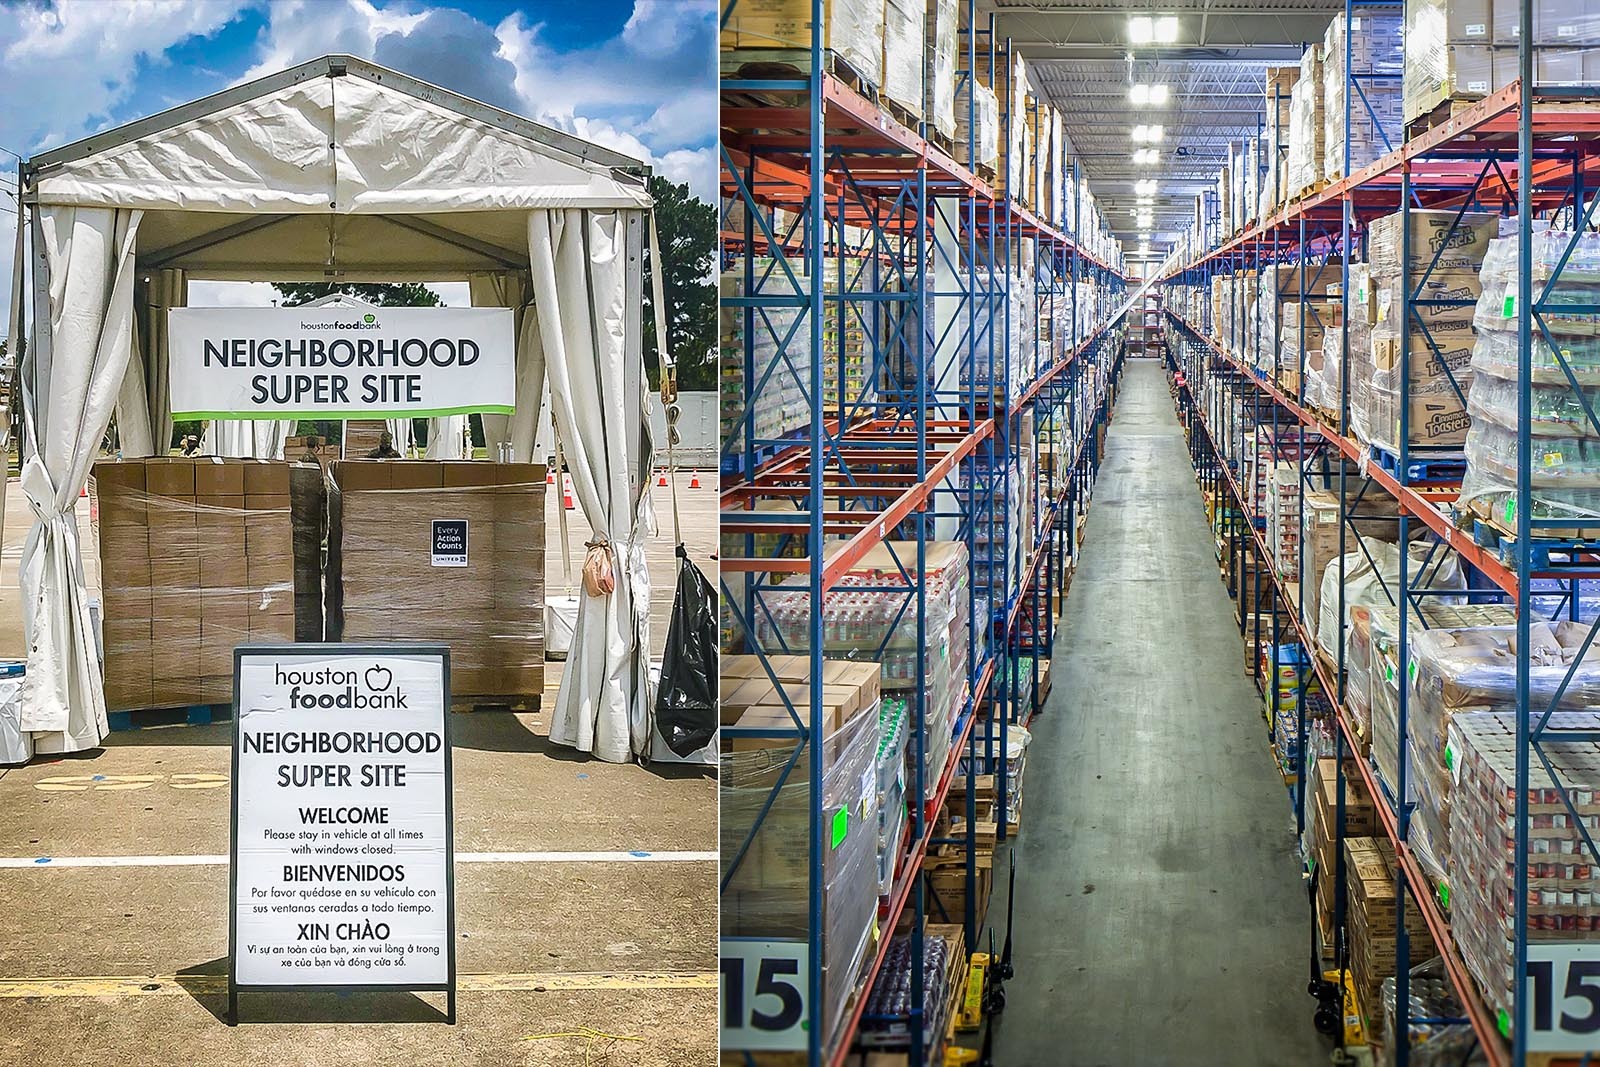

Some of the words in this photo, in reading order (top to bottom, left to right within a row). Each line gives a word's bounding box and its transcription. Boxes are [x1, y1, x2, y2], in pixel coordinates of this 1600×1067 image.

[301, 320, 381, 330] houstonfoodbank
[203, 338, 480, 368] NEIGHBORHOOD
[250, 374, 350, 405] SUPER
[360, 374, 422, 404] SITE
[1427, 417, 1471, 437] Toasters
[437, 526, 458, 534] Every
[275, 663, 358, 686] houston
[290, 686, 408, 709] foodbank
[242, 731, 442, 754] NEIGHBORHOOD
[277, 764, 353, 788] SUPER
[360, 764, 407, 788] SITE
[298, 807, 389, 825] WELCOME
[264, 828, 296, 840] Please
[298, 830, 319, 842] stay
[321, 829, 331, 839] in
[333, 828, 368, 840] vehicle
[370, 830, 381, 840] at
[383, 828, 396, 840] all
[398, 829, 424, 840] times
[290, 843, 312, 855] with
[314, 843, 359, 855] windows
[361, 843, 397, 855] closed.
[283, 864, 405, 882] BIENVENIDOS
[251, 887, 268, 898] Por
[270, 886, 297, 898] favor
[299, 886, 342, 900] quédase
[344, 889, 357, 897] en
[360, 889, 371, 897] su
[373, 885, 415, 897] vehículo
[417, 889, 436, 898] con
[252, 905, 269, 914] sus
[271, 904, 316, 913] ventanas
[318, 901, 359, 913] ceradas
[361, 904, 369, 913] a
[371, 901, 395, 913] todo
[397, 902, 434, 916] tiempo.
[296, 923, 330, 941] XIN
[335, 918, 391, 941] CHÀO
[272, 946, 285, 954] an
[352, 944, 366, 954] xin
[368, 944, 382, 954] vui
[416, 945, 440, 956] trong
[280, 960, 293, 968] xe
[720, 958, 803, 1032] 15
[1526, 961, 1600, 1034] 15
